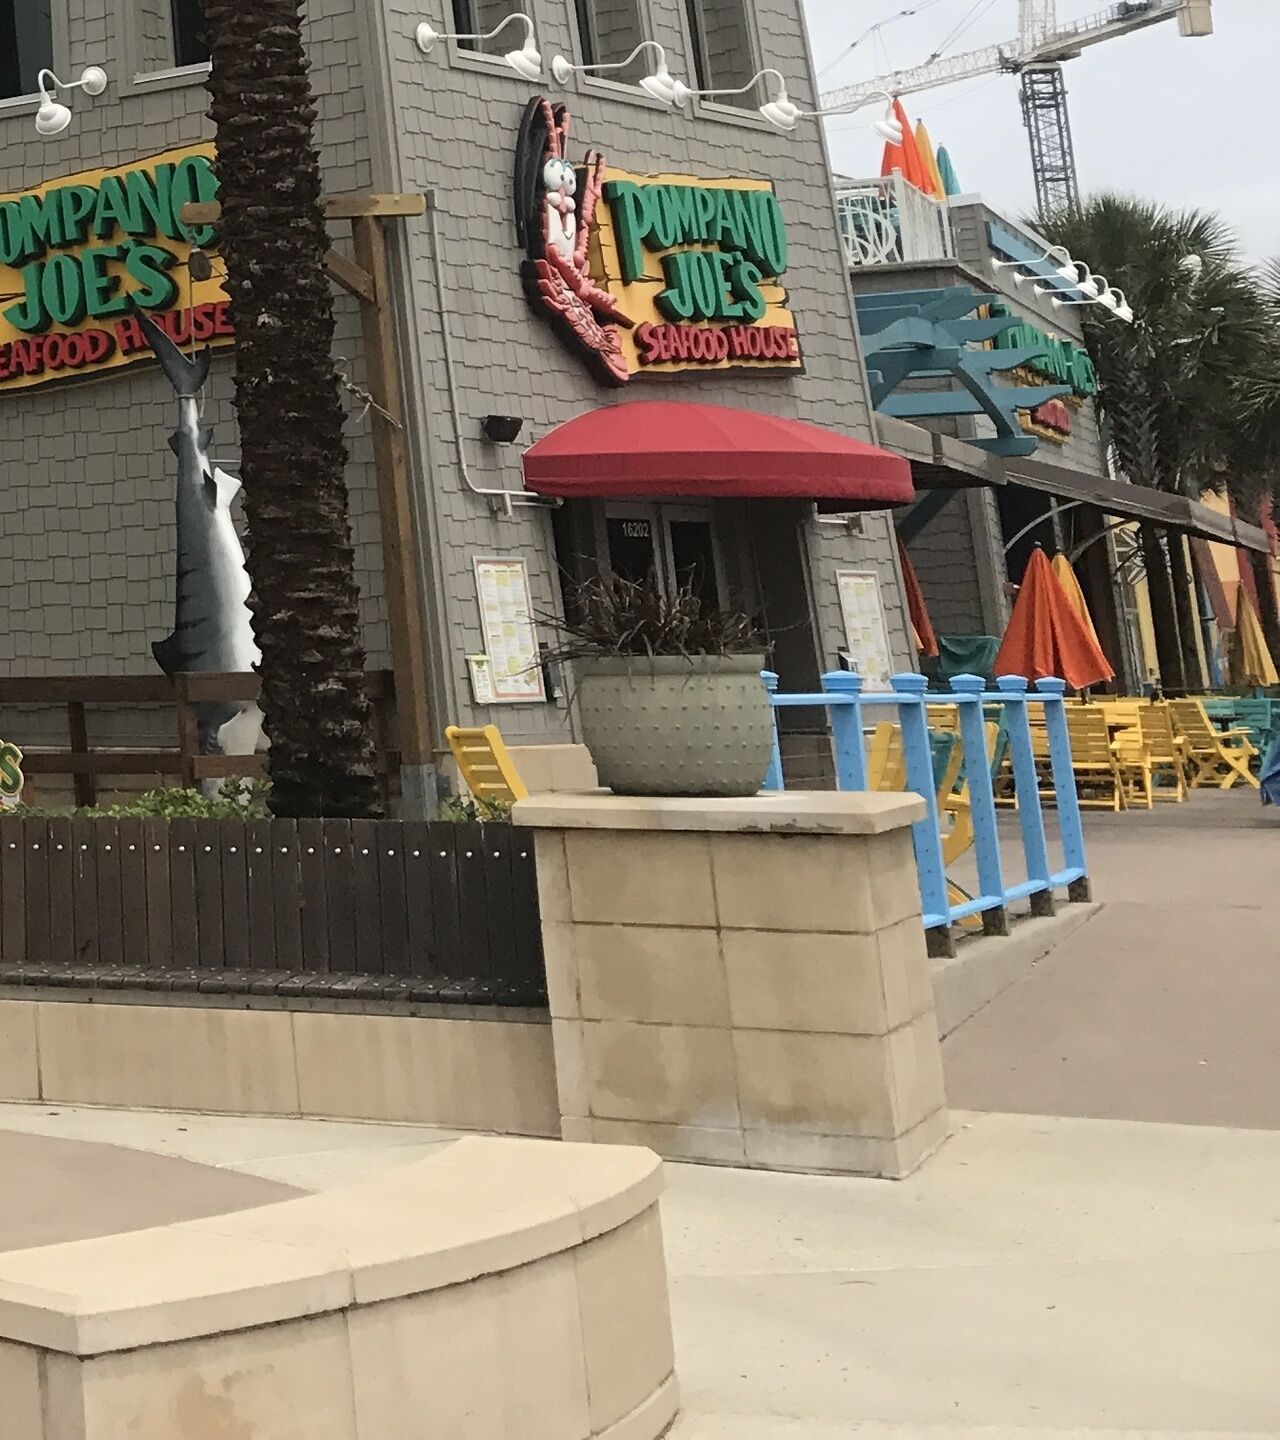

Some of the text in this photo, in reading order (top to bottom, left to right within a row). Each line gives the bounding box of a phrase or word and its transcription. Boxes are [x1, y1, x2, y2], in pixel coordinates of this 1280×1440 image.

[604, 180, 788, 282] POMPANO
[2, 238, 178, 334] JOE'S
[655, 250, 767, 322] JOE'S
[634, 322, 800, 364] SEAFOOD HOUSE
